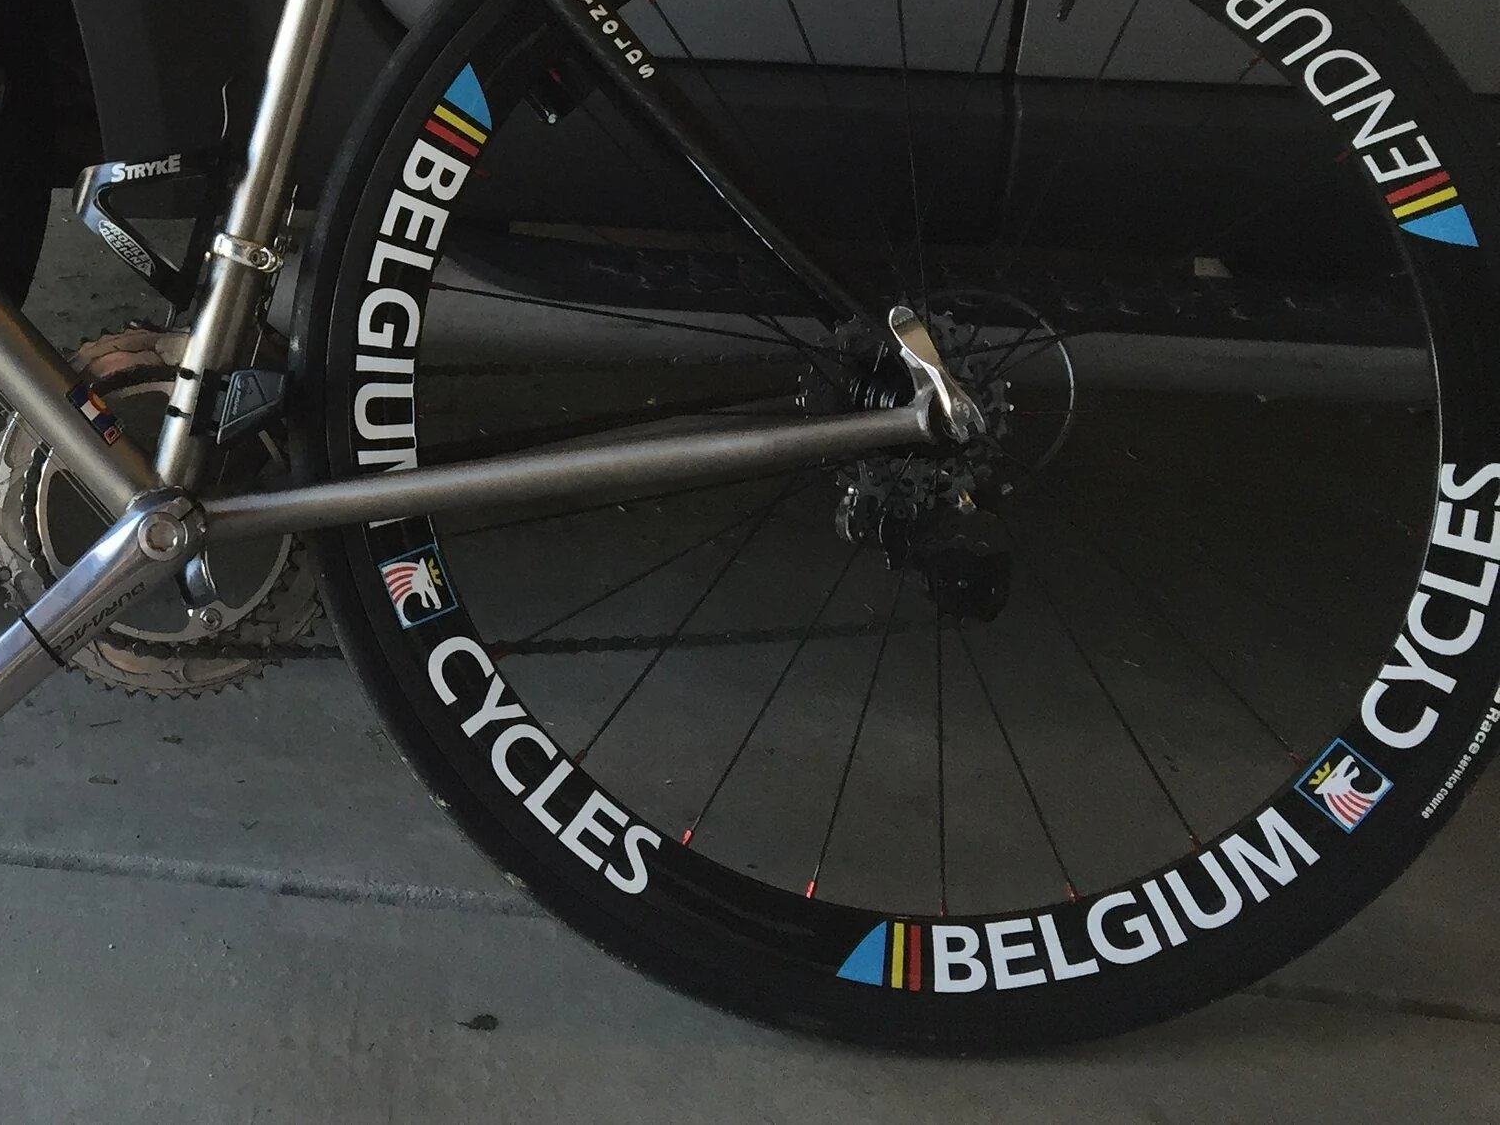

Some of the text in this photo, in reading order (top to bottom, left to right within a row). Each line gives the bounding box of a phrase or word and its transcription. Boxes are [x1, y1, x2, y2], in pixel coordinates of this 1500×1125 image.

[111, 154, 182, 183] STRYKE
[1359, 461, 1500, 750] CYCLES
[426, 635, 663, 895] CYCLES
[1421, 787, 1449, 820] course
[1444, 753, 1473, 790] service
[931, 805, 1321, 995] BELGIUM
